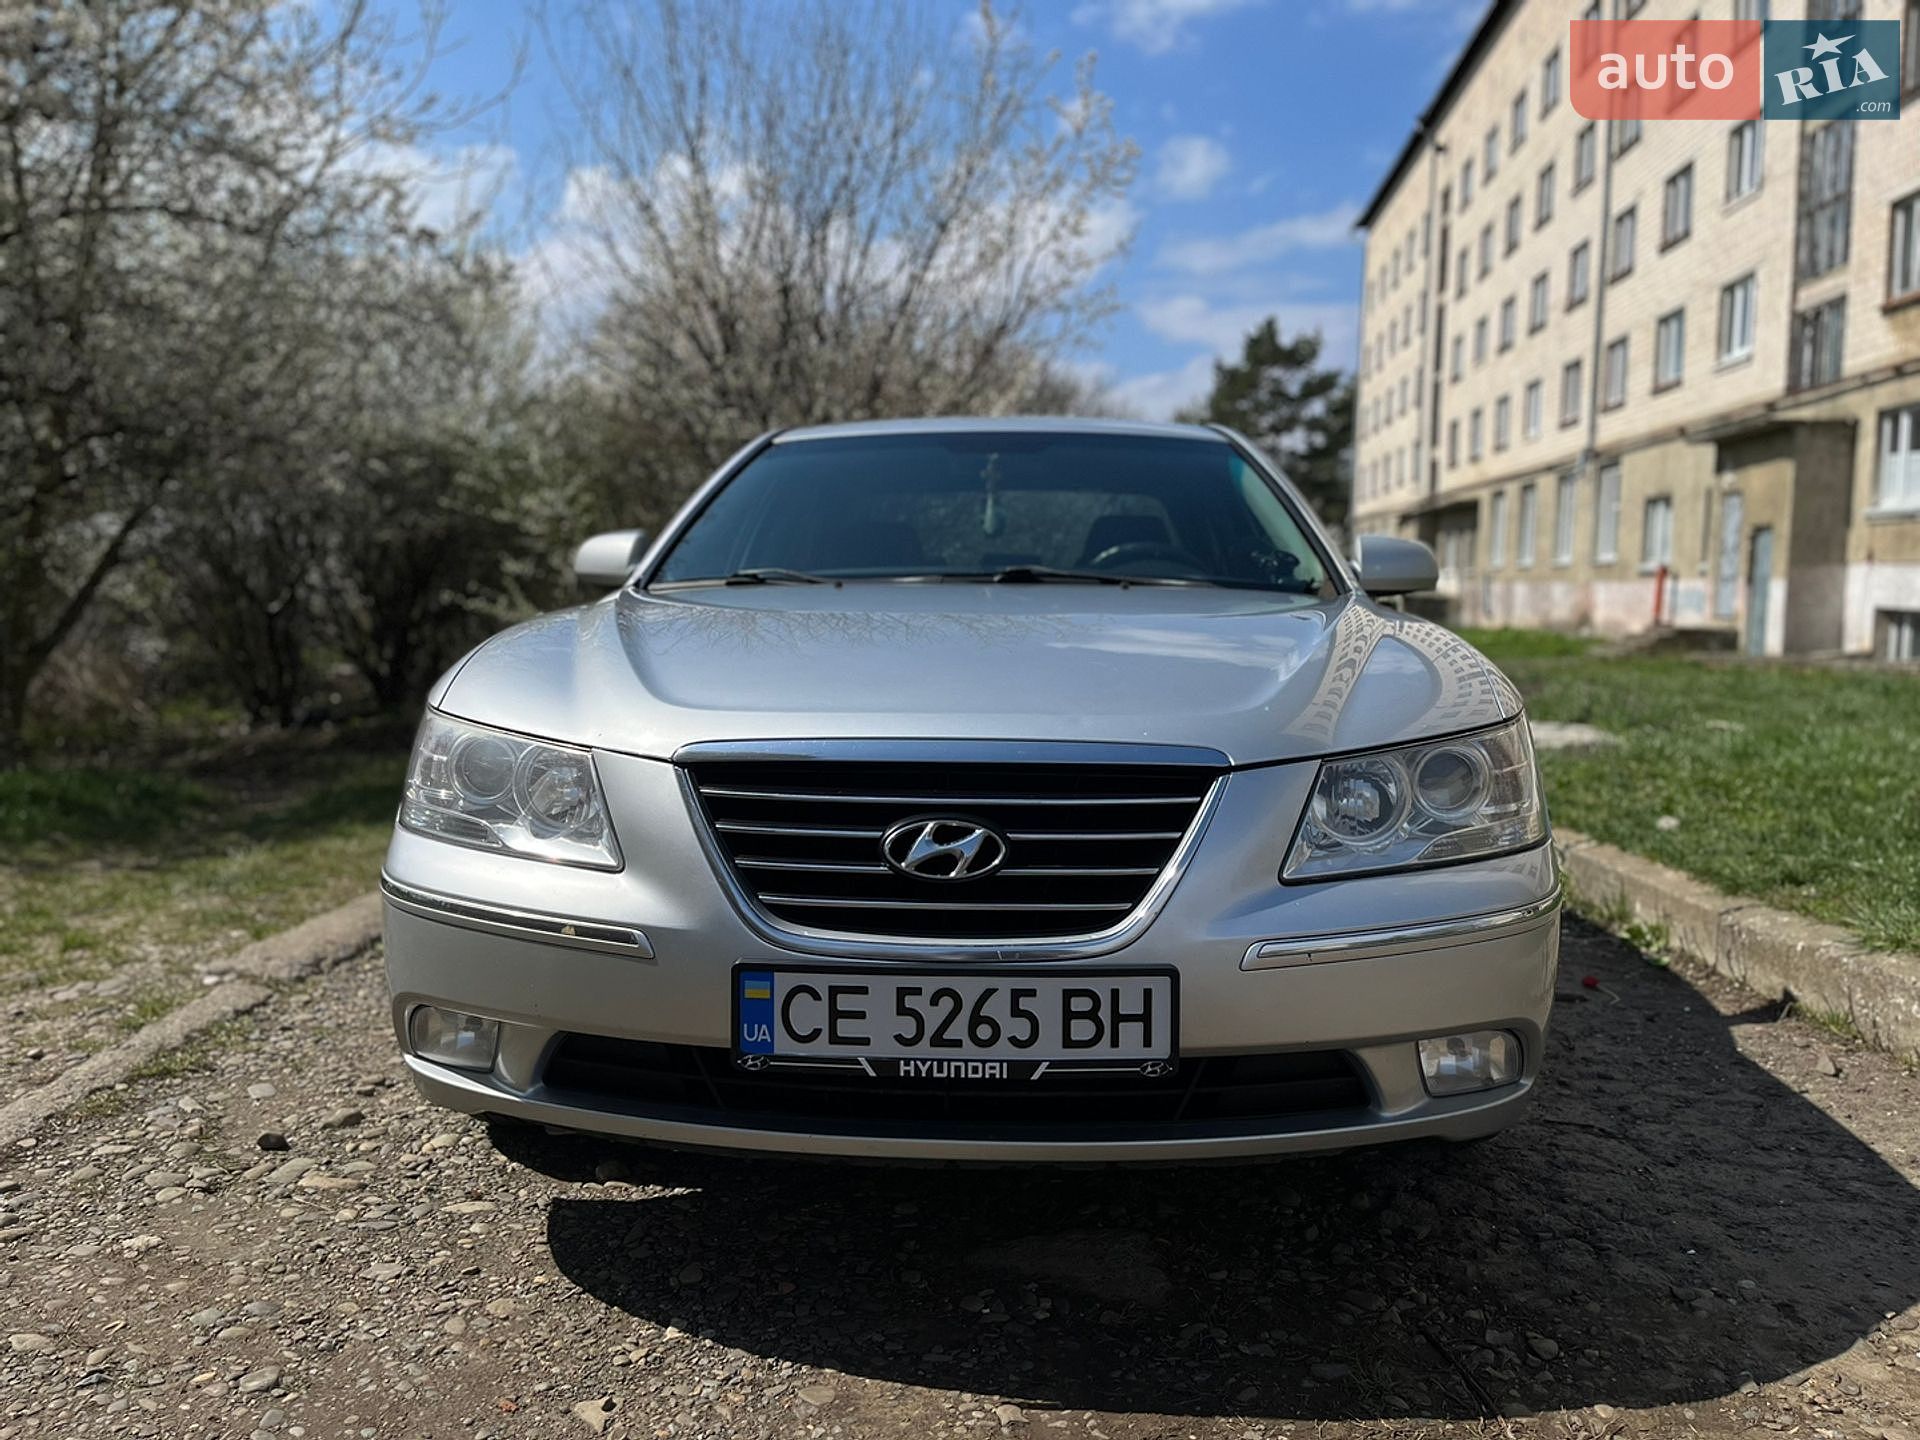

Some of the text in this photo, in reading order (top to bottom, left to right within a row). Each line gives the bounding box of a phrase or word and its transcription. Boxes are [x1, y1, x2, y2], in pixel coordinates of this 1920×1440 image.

[781, 985, 1153, 1048] CE 5265 BH
[743, 1023, 771, 1042] UA
[900, 1060, 1008, 1079] HYUNDAI
